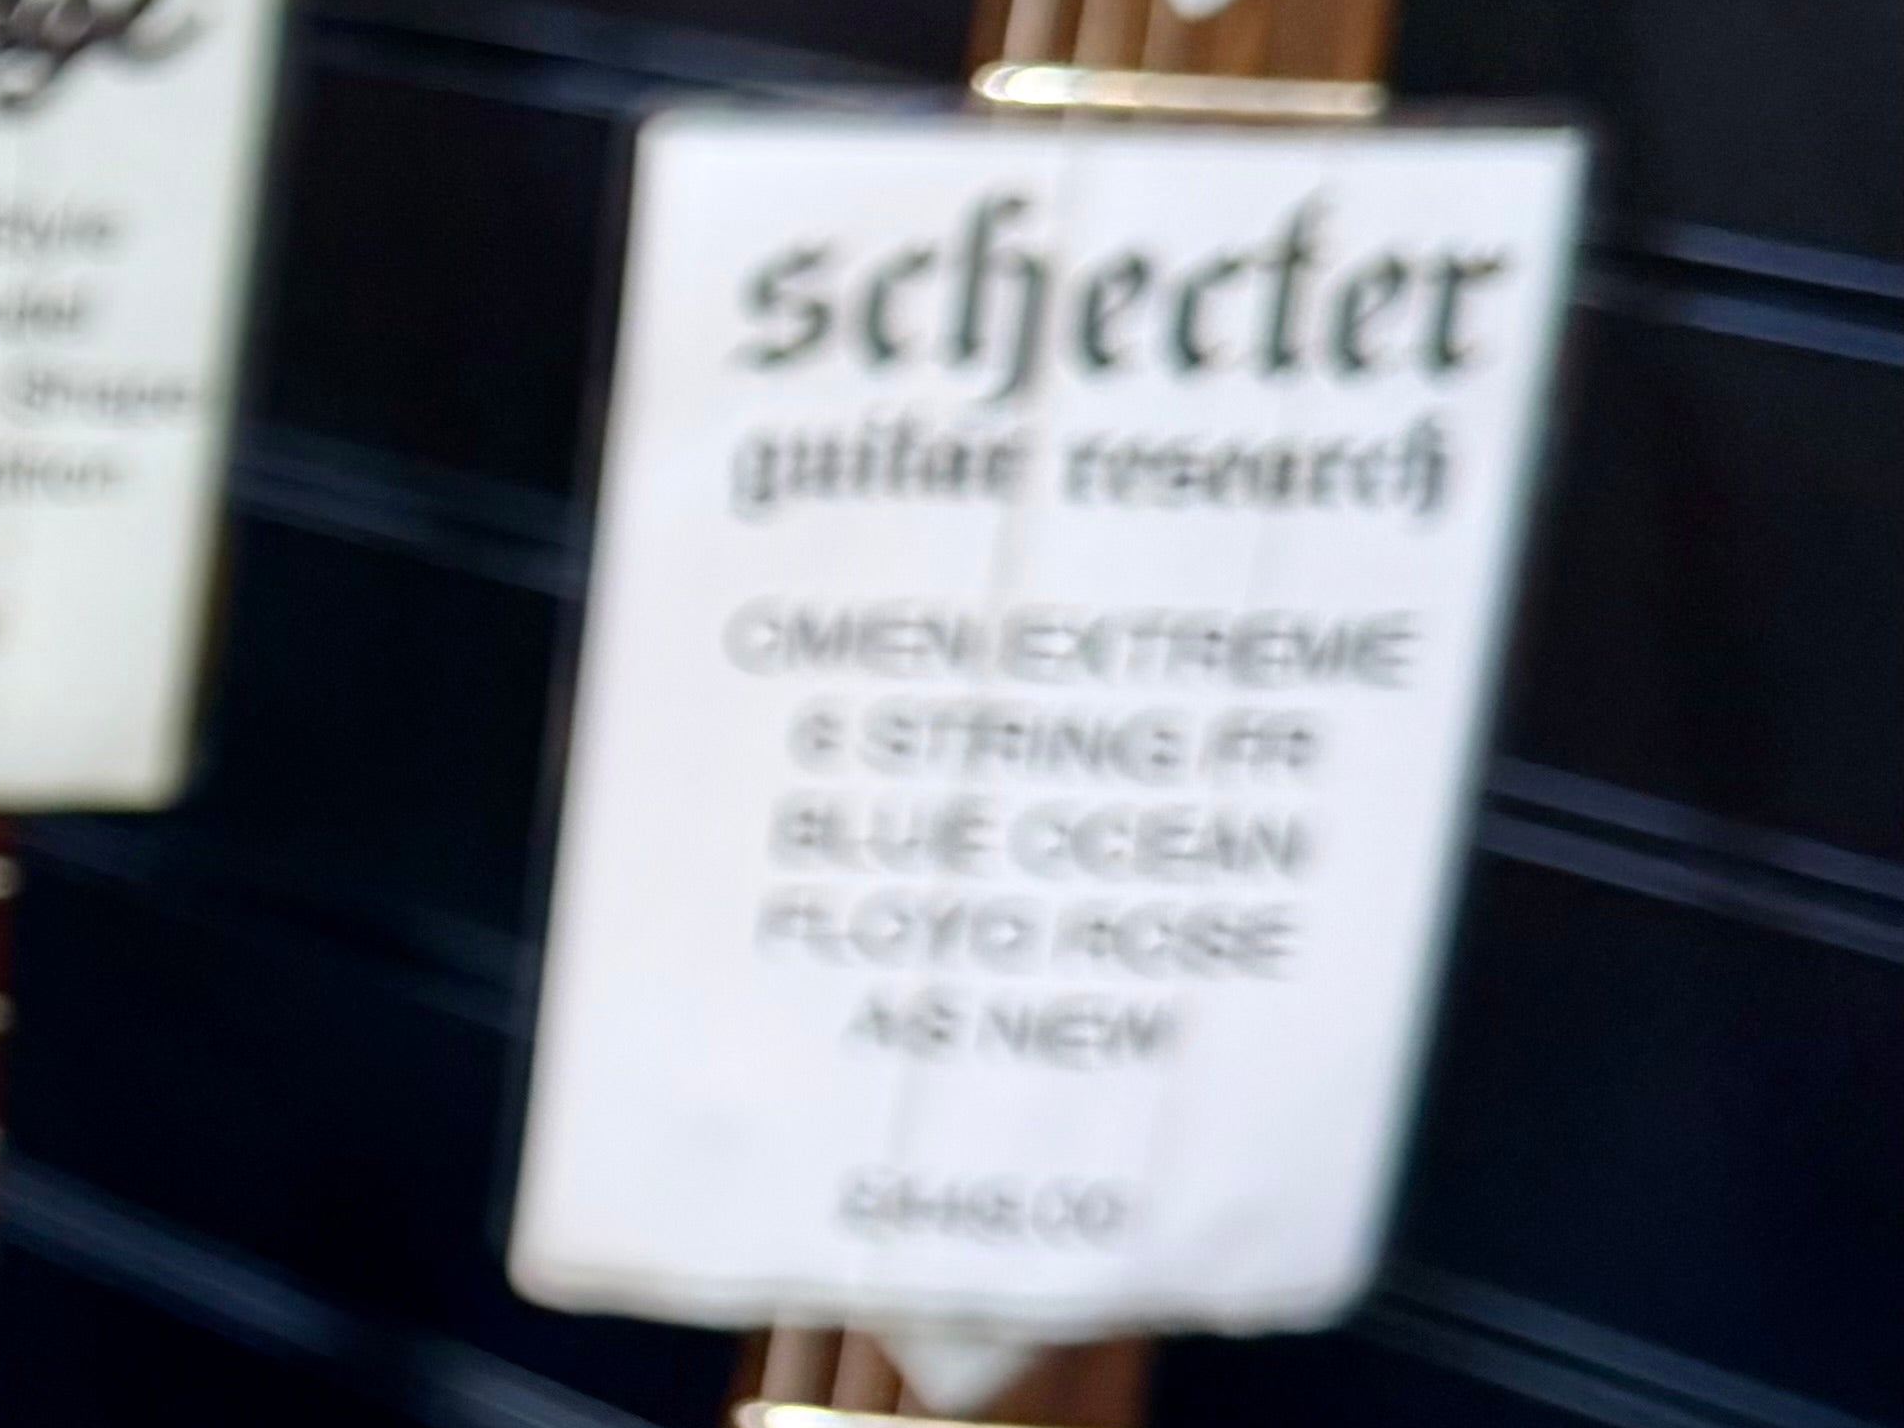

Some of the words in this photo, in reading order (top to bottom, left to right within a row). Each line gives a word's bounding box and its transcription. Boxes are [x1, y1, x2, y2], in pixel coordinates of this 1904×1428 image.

[732, 184, 1510, 404] schecter
[726, 407, 1030, 518] guitar
[1061, 407, 1452, 530] research
[723, 598, 982, 678] OMEN
[995, 604, 1422, 690] EXTREME
[859, 698, 1185, 782] STRING
[768, 794, 993, 874] BLUE
[1008, 800, 1311, 882] OCEAN
[755, 886, 1040, 969] FLOYD
[1052, 898, 1299, 981] ROSE
[977, 991, 1182, 1068] NEW
